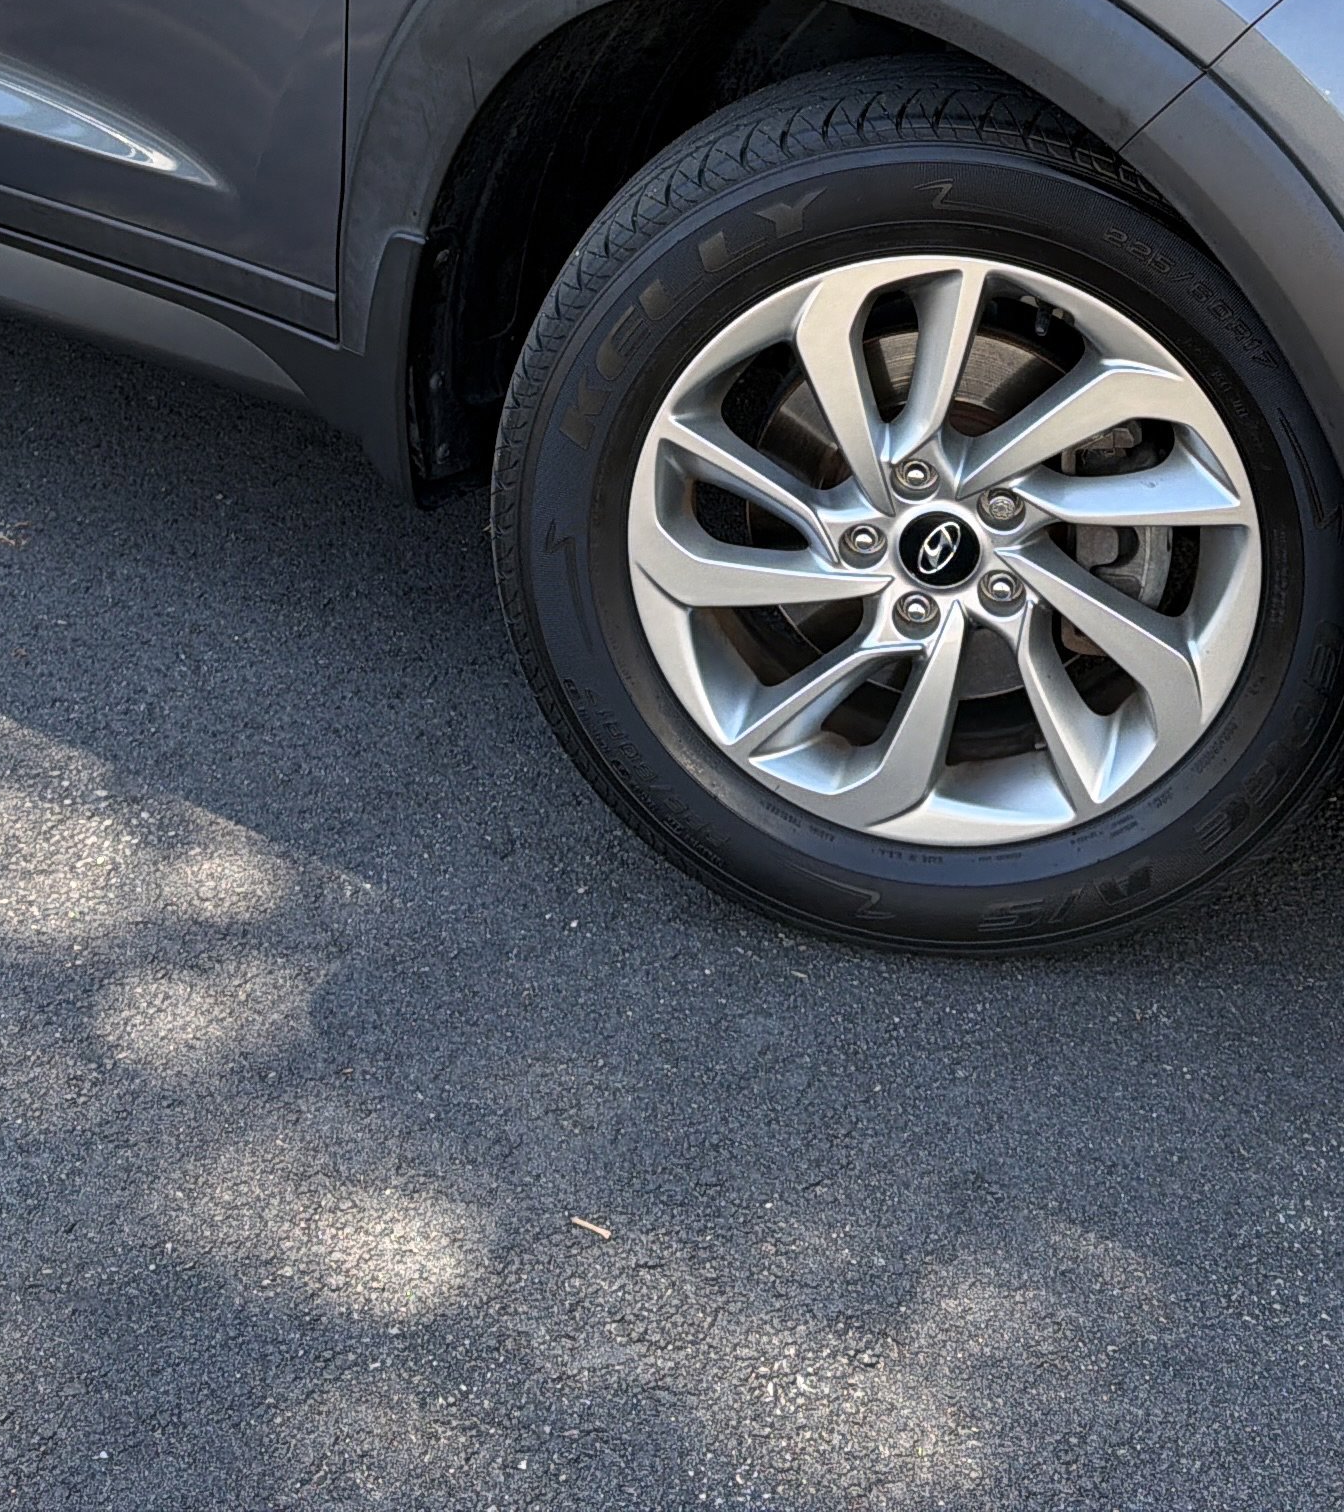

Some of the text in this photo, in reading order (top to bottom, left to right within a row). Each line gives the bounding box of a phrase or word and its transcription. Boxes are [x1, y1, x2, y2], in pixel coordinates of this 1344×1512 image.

[559, 188, 828, 451] KELLY
[1104, 226, 1280, 371] 225/60R17
[978, 620, 1344, 932] EDGE A/S
